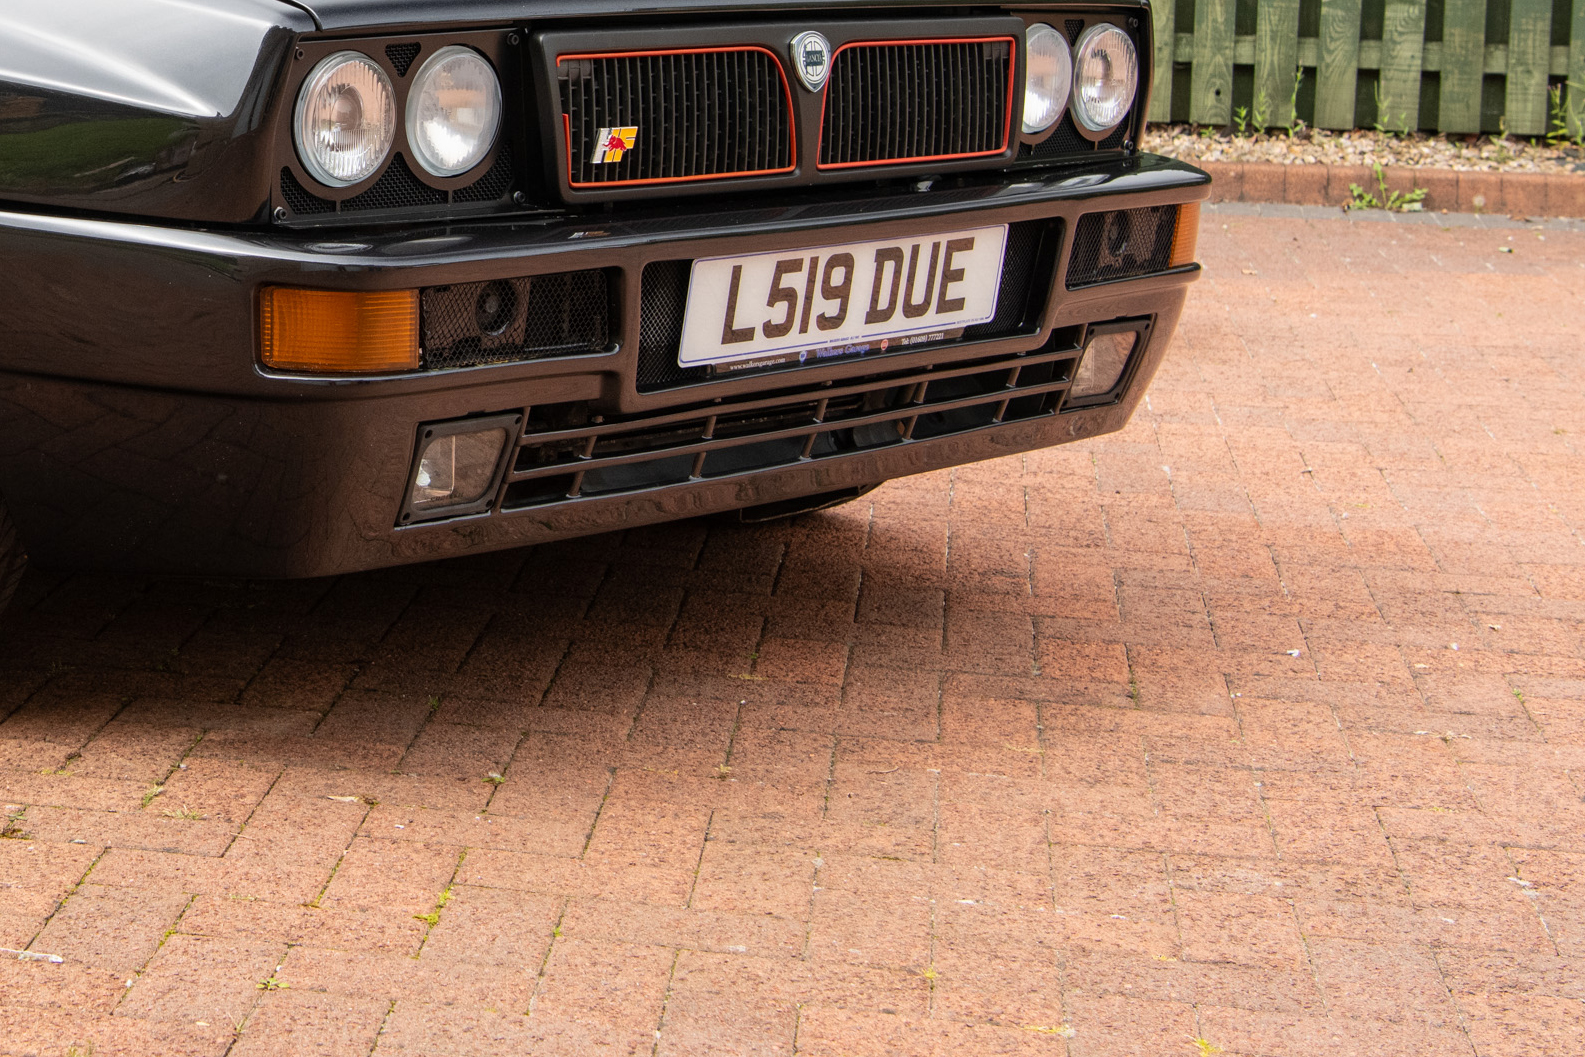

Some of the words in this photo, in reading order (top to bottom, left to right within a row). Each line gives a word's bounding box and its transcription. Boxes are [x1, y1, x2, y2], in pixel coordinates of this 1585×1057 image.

[720, 252, 855, 345] L519
[864, 236, 975, 325] DUE
[816, 347, 844, 359] Walkers
